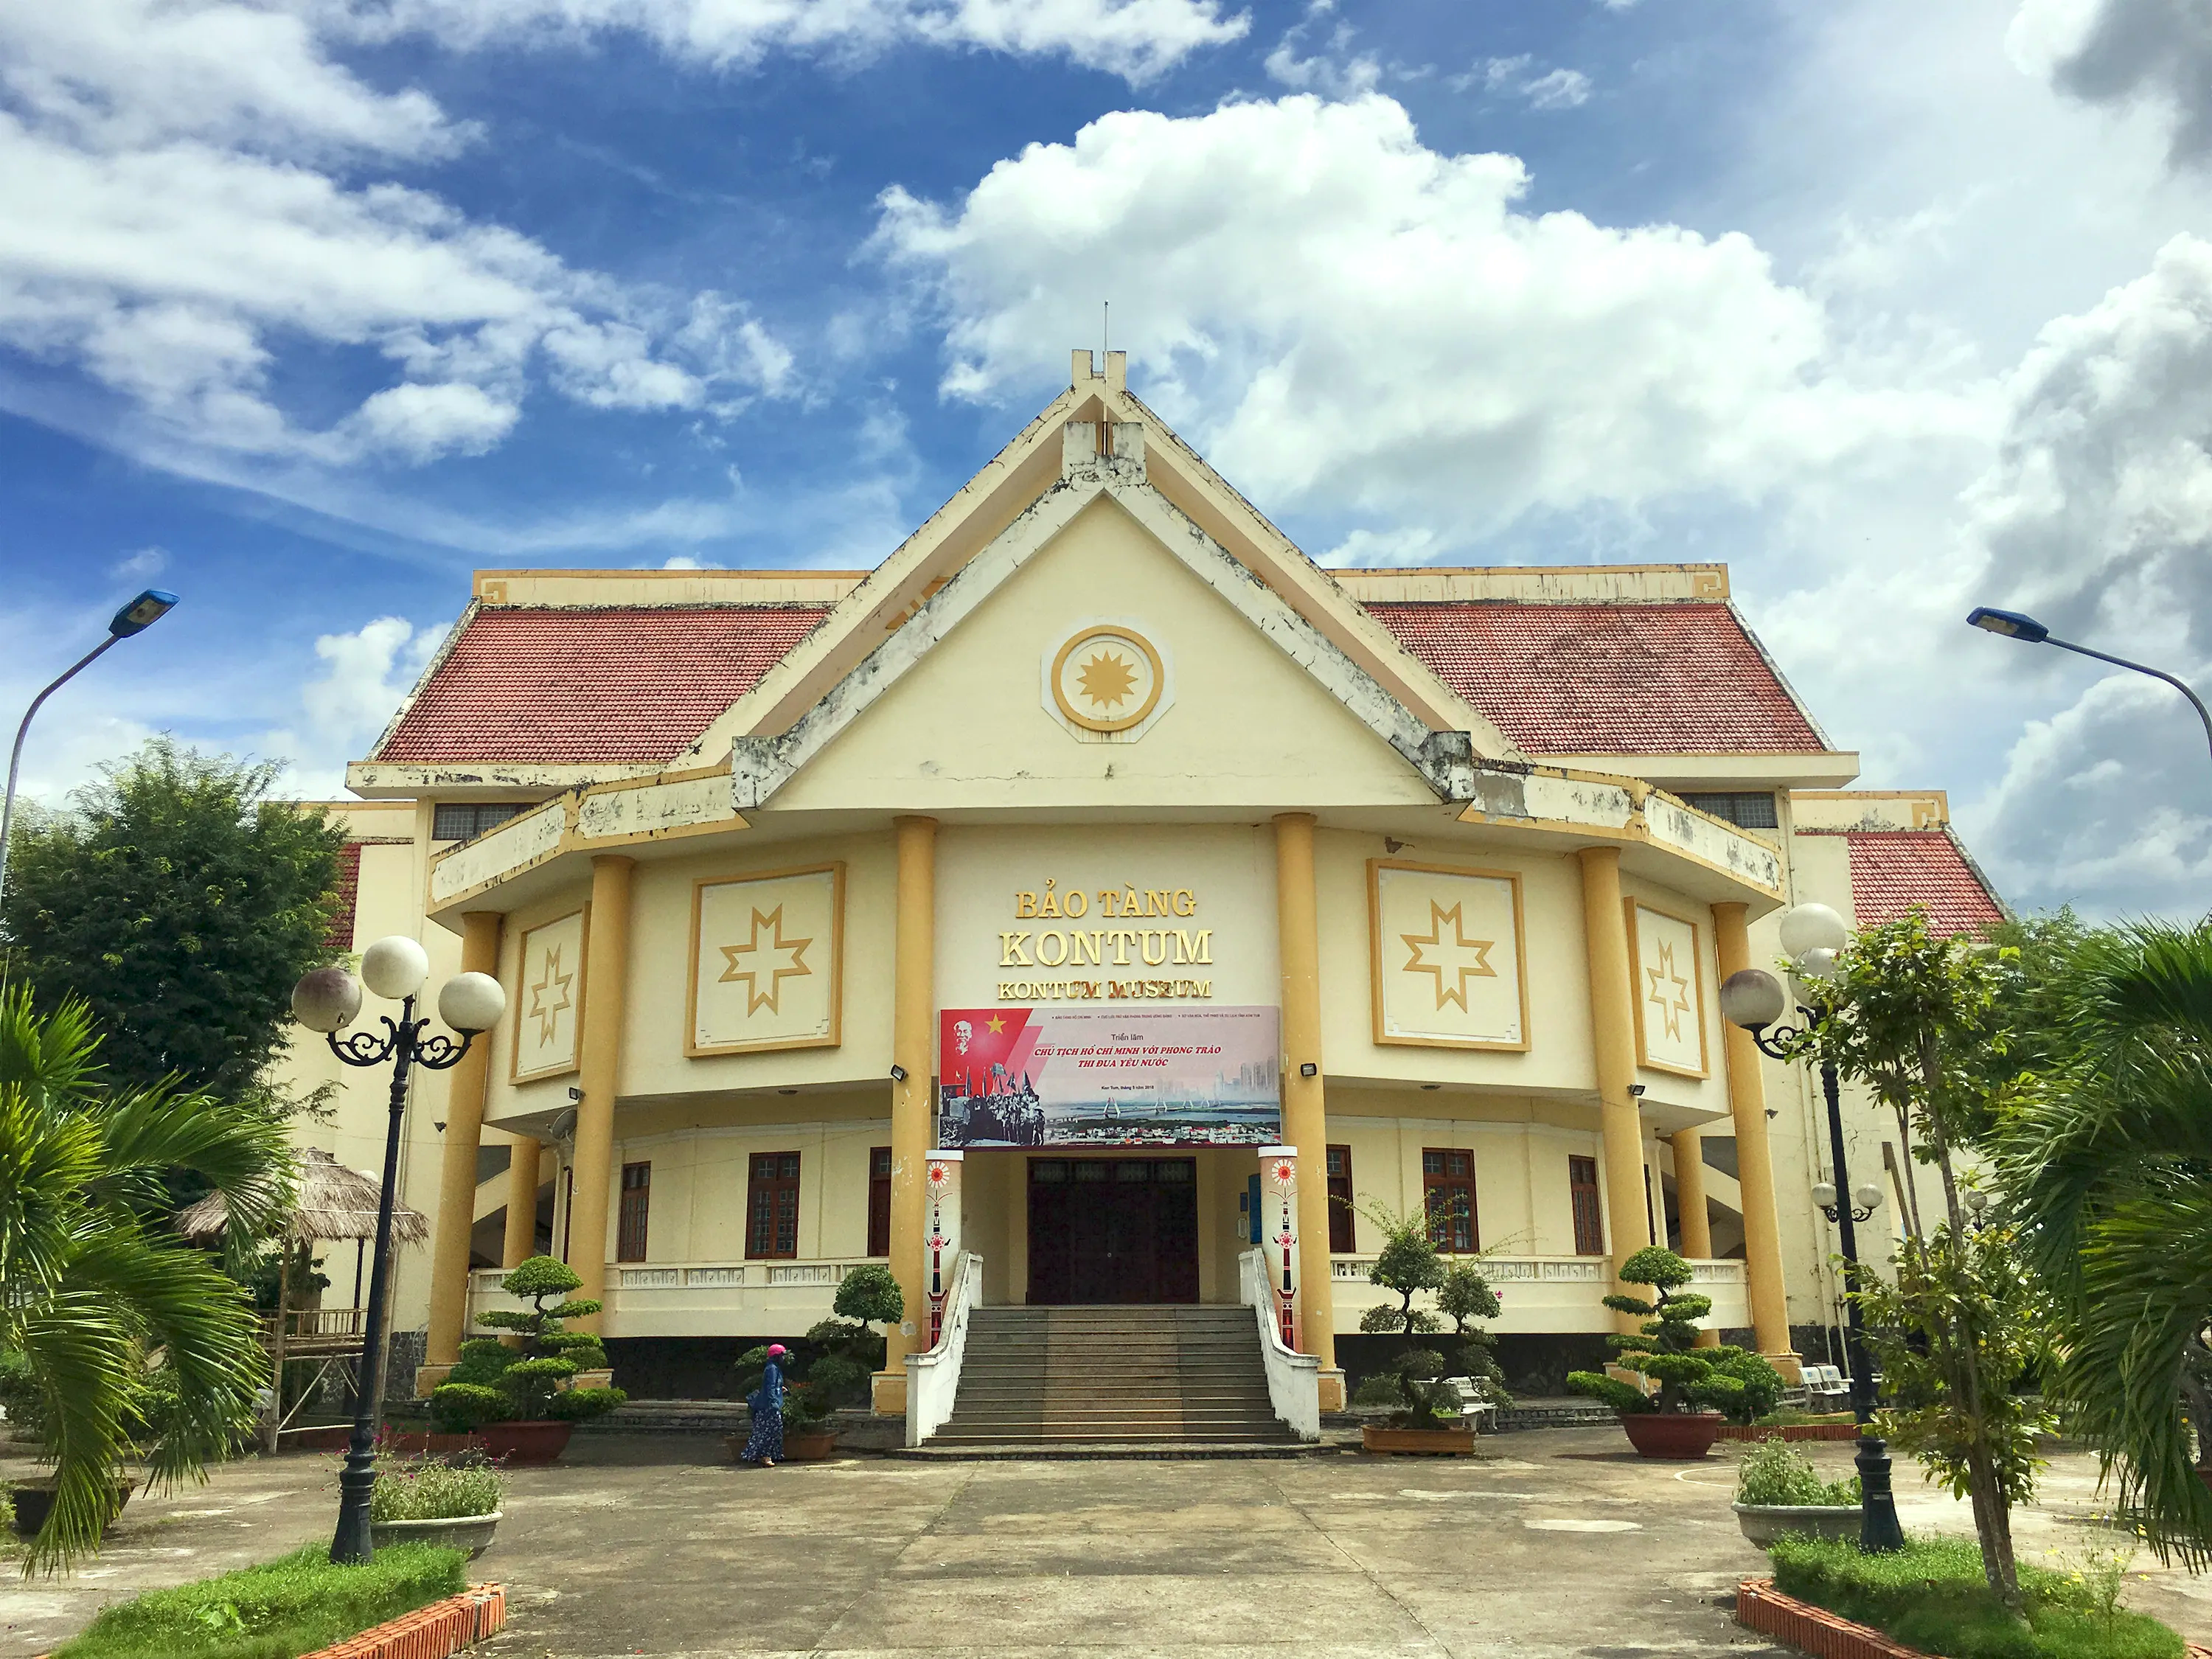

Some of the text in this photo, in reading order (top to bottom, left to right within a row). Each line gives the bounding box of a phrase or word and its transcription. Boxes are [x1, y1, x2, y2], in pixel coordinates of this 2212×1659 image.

[1015, 877, 1197, 918] BẢO TÀNG
[998, 929, 1213, 966] KONTUM
[998, 979, 1212, 999] KONTUM MUSEUM
[1110, 1032, 1128, 1040] Triển
[1034, 1046, 1055, 1056] CHỦ
[1057, 1048, 1079, 1057] TỊCH
[1079, 1044, 1095, 1055] HỒ
[1096, 1046, 1114, 1055] CHÍ
[1142, 1045, 1159, 1054] VỚI
[1160, 1046, 1193, 1054] PHONG
[1195, 1044, 1221, 1054] TRÀO
[1078, 1060, 1096, 1068] THI
[1119, 1057, 1139, 1067] YÊU
[1140, 1057, 1169, 1067] NƯỚC
